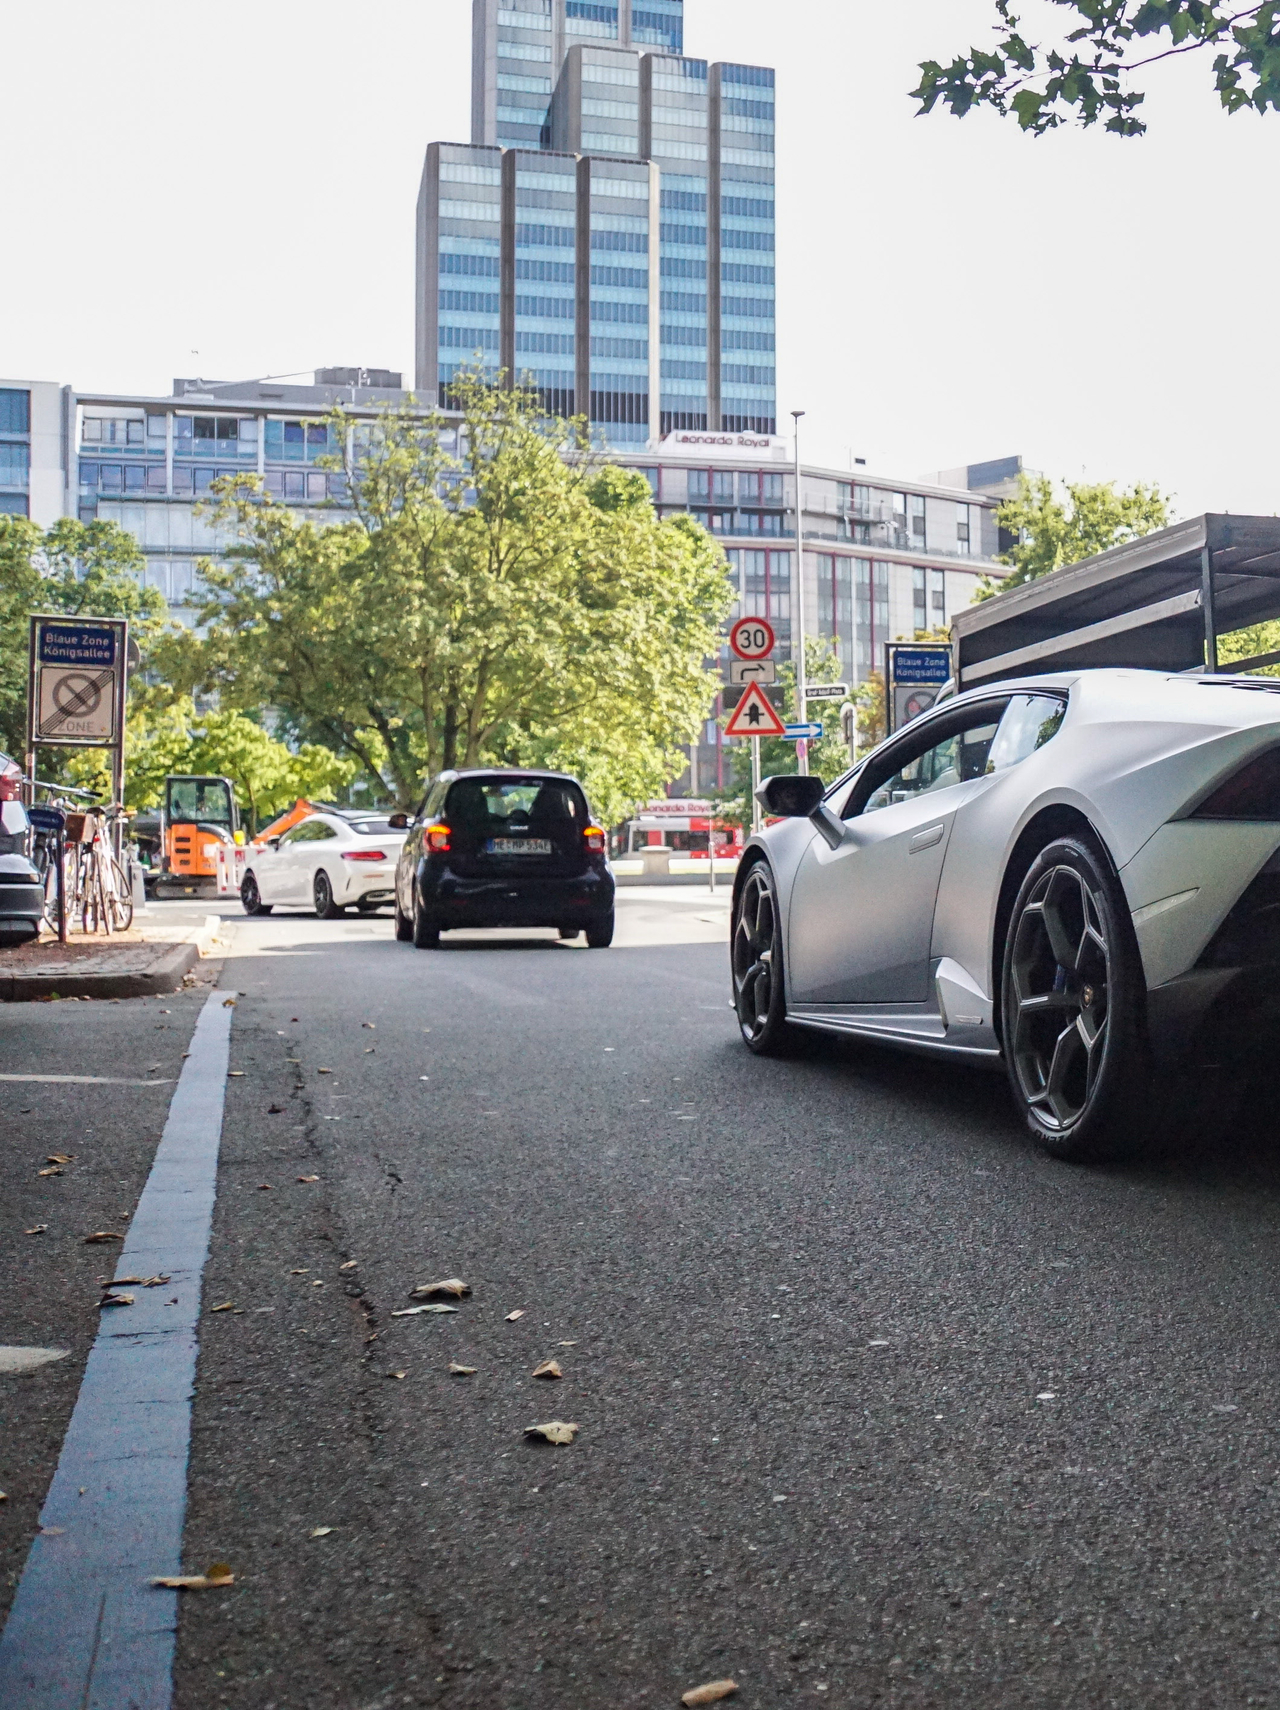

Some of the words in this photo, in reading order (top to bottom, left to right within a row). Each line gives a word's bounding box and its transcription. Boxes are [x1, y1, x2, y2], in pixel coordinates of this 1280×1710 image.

[675, 432, 733, 445] Leonardo
[737, 435, 770, 448] Royal
[46, 632, 78, 645] Blaue
[82, 634, 110, 647] Zone
[740, 629, 765, 649] 30
[44, 645, 111, 659] Königsallee
[897, 656, 922, 666] Blaue
[924, 657, 946, 666] Zone
[896, 668, 947, 679] Königsallee
[58, 721, 94, 733] ZONE
